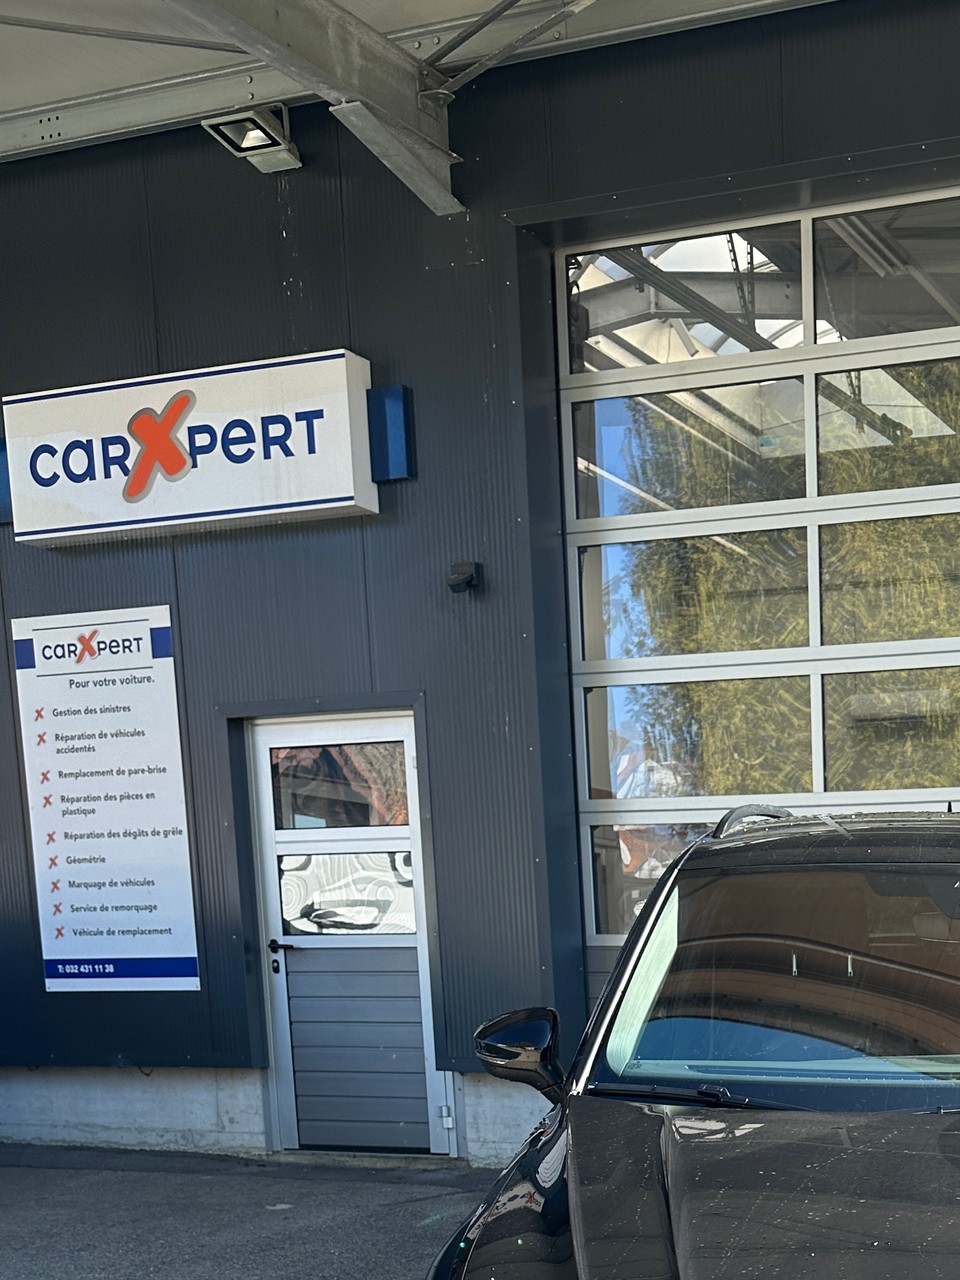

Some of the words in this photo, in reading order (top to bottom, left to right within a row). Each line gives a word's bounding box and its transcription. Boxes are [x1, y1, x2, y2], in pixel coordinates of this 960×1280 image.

[69, 679, 90, 689] Pour
[93, 677, 117, 687] votre
[120, 674, 155, 686] voiture.
[52, 707, 82, 718] Gestion
[84, 706, 98, 715] des
[100, 704, 131, 714] sinistres
[55, 731, 96, 743] Réparation
[98, 731, 108, 739] de
[110, 728, 145, 739] véhicules
[56, 745, 96, 754] accidentés
[58, 769, 114, 780] Remplacement
[116, 768, 127, 777] de
[128, 765, 167, 777] pare-brise
[60, 794, 102, 805] Réparation
[104, 792, 117, 801] des
[119, 792, 144, 803] pièces
[62, 807, 96, 818] plastique
[64, 830, 105, 842] Réparation
[107, 829, 120, 838] des
[122, 828, 149, 839] dégâts
[151, 828, 161, 837] de
[66, 855, 106, 865] Géométrie
[68, 880, 107, 890] Marquage
[108, 879, 118, 887] de
[120, 878, 155, 887] véhicules
[70, 904, 98, 913] Service
[99, 903, 109, 912] de
[111, 903, 158, 914] remorquage
[72, 927, 104, 937] Véhicule
[106, 927, 116, 936] de
[117, 926, 172, 938] remplacement
[65, 964, 79, 973] 032
[80, 964, 93, 973] 431
[94, 964, 103, 973] 11
